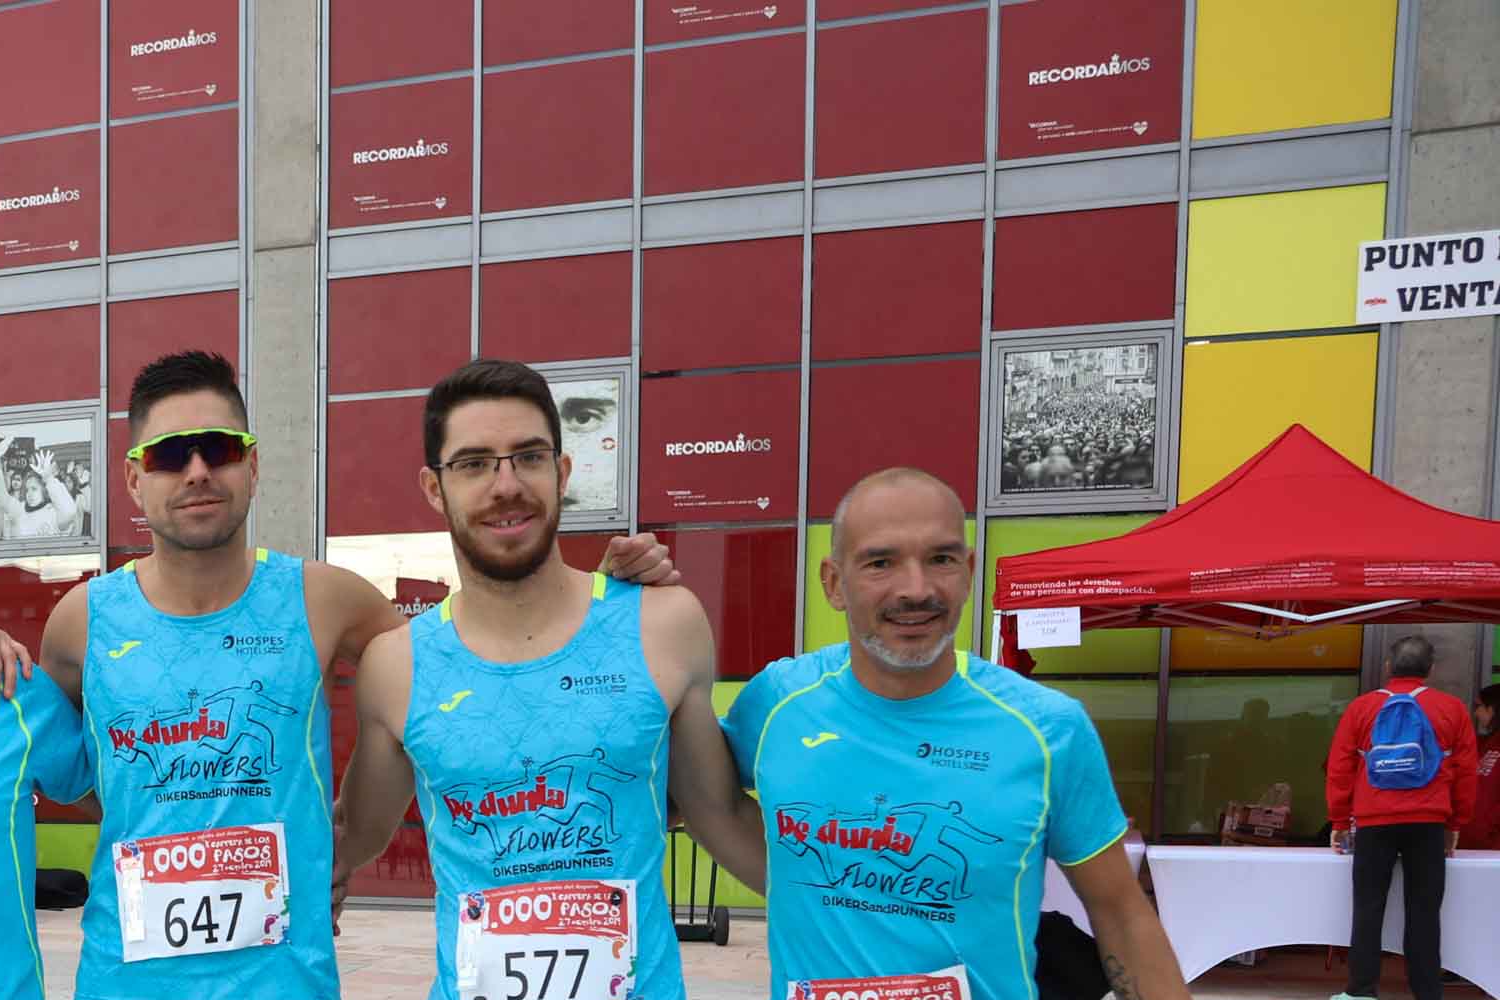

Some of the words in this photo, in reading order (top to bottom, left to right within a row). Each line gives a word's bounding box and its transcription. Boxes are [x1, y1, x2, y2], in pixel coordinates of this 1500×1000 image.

[1364, 237, 1484, 272] PUNTO
[1396, 281, 1500, 312] VENT
[236, 635, 284, 646] HOSPES
[574, 674, 626, 686] HOSPES
[169, 754, 263, 781] FLOWERS
[932, 747, 990, 762] HOSPES
[505, 825, 604, 853] FLOWERS
[213, 845, 271, 863] PASOS
[840, 861, 949, 901] FLOWERS
[165, 892, 243, 948] 647
